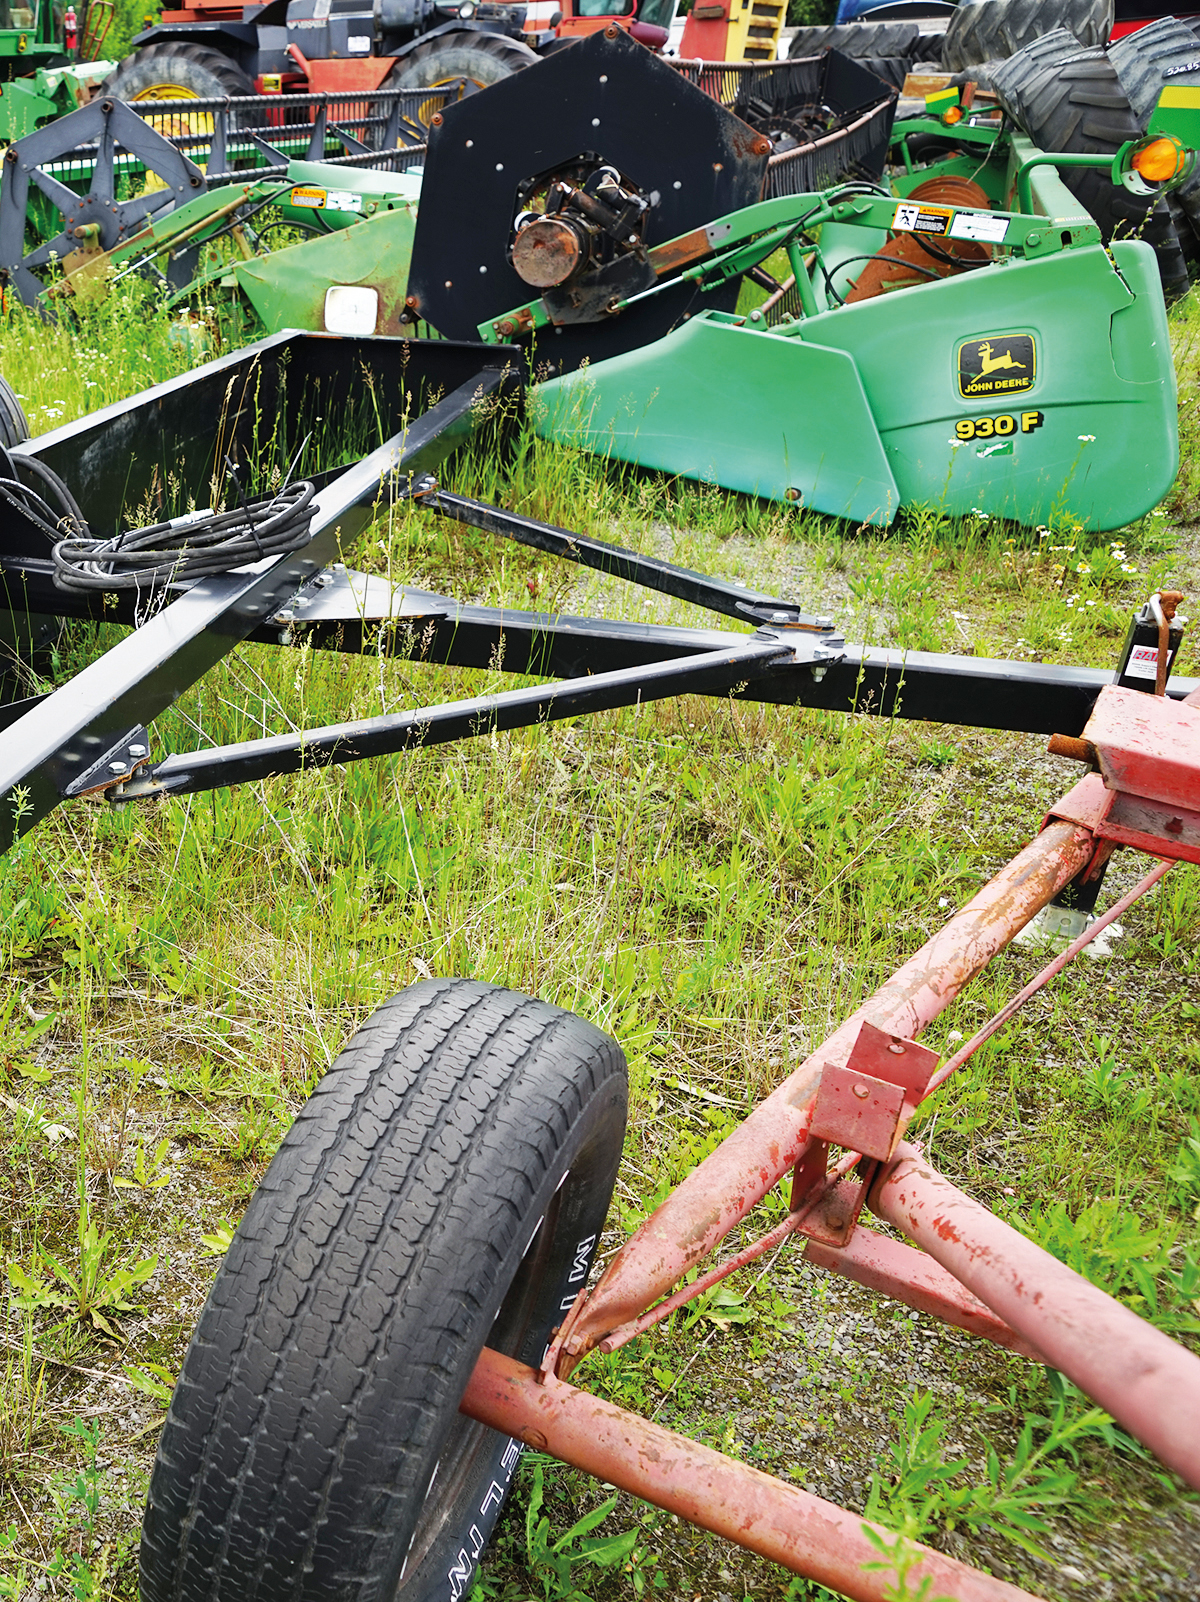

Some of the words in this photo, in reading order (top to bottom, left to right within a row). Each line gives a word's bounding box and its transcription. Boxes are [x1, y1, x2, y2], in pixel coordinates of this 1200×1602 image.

[964, 382, 993, 393] JOHN
[994, 377, 1029, 390] DEERE
[955, 414, 1017, 440] 930
[1021, 411, 1044, 434] F
